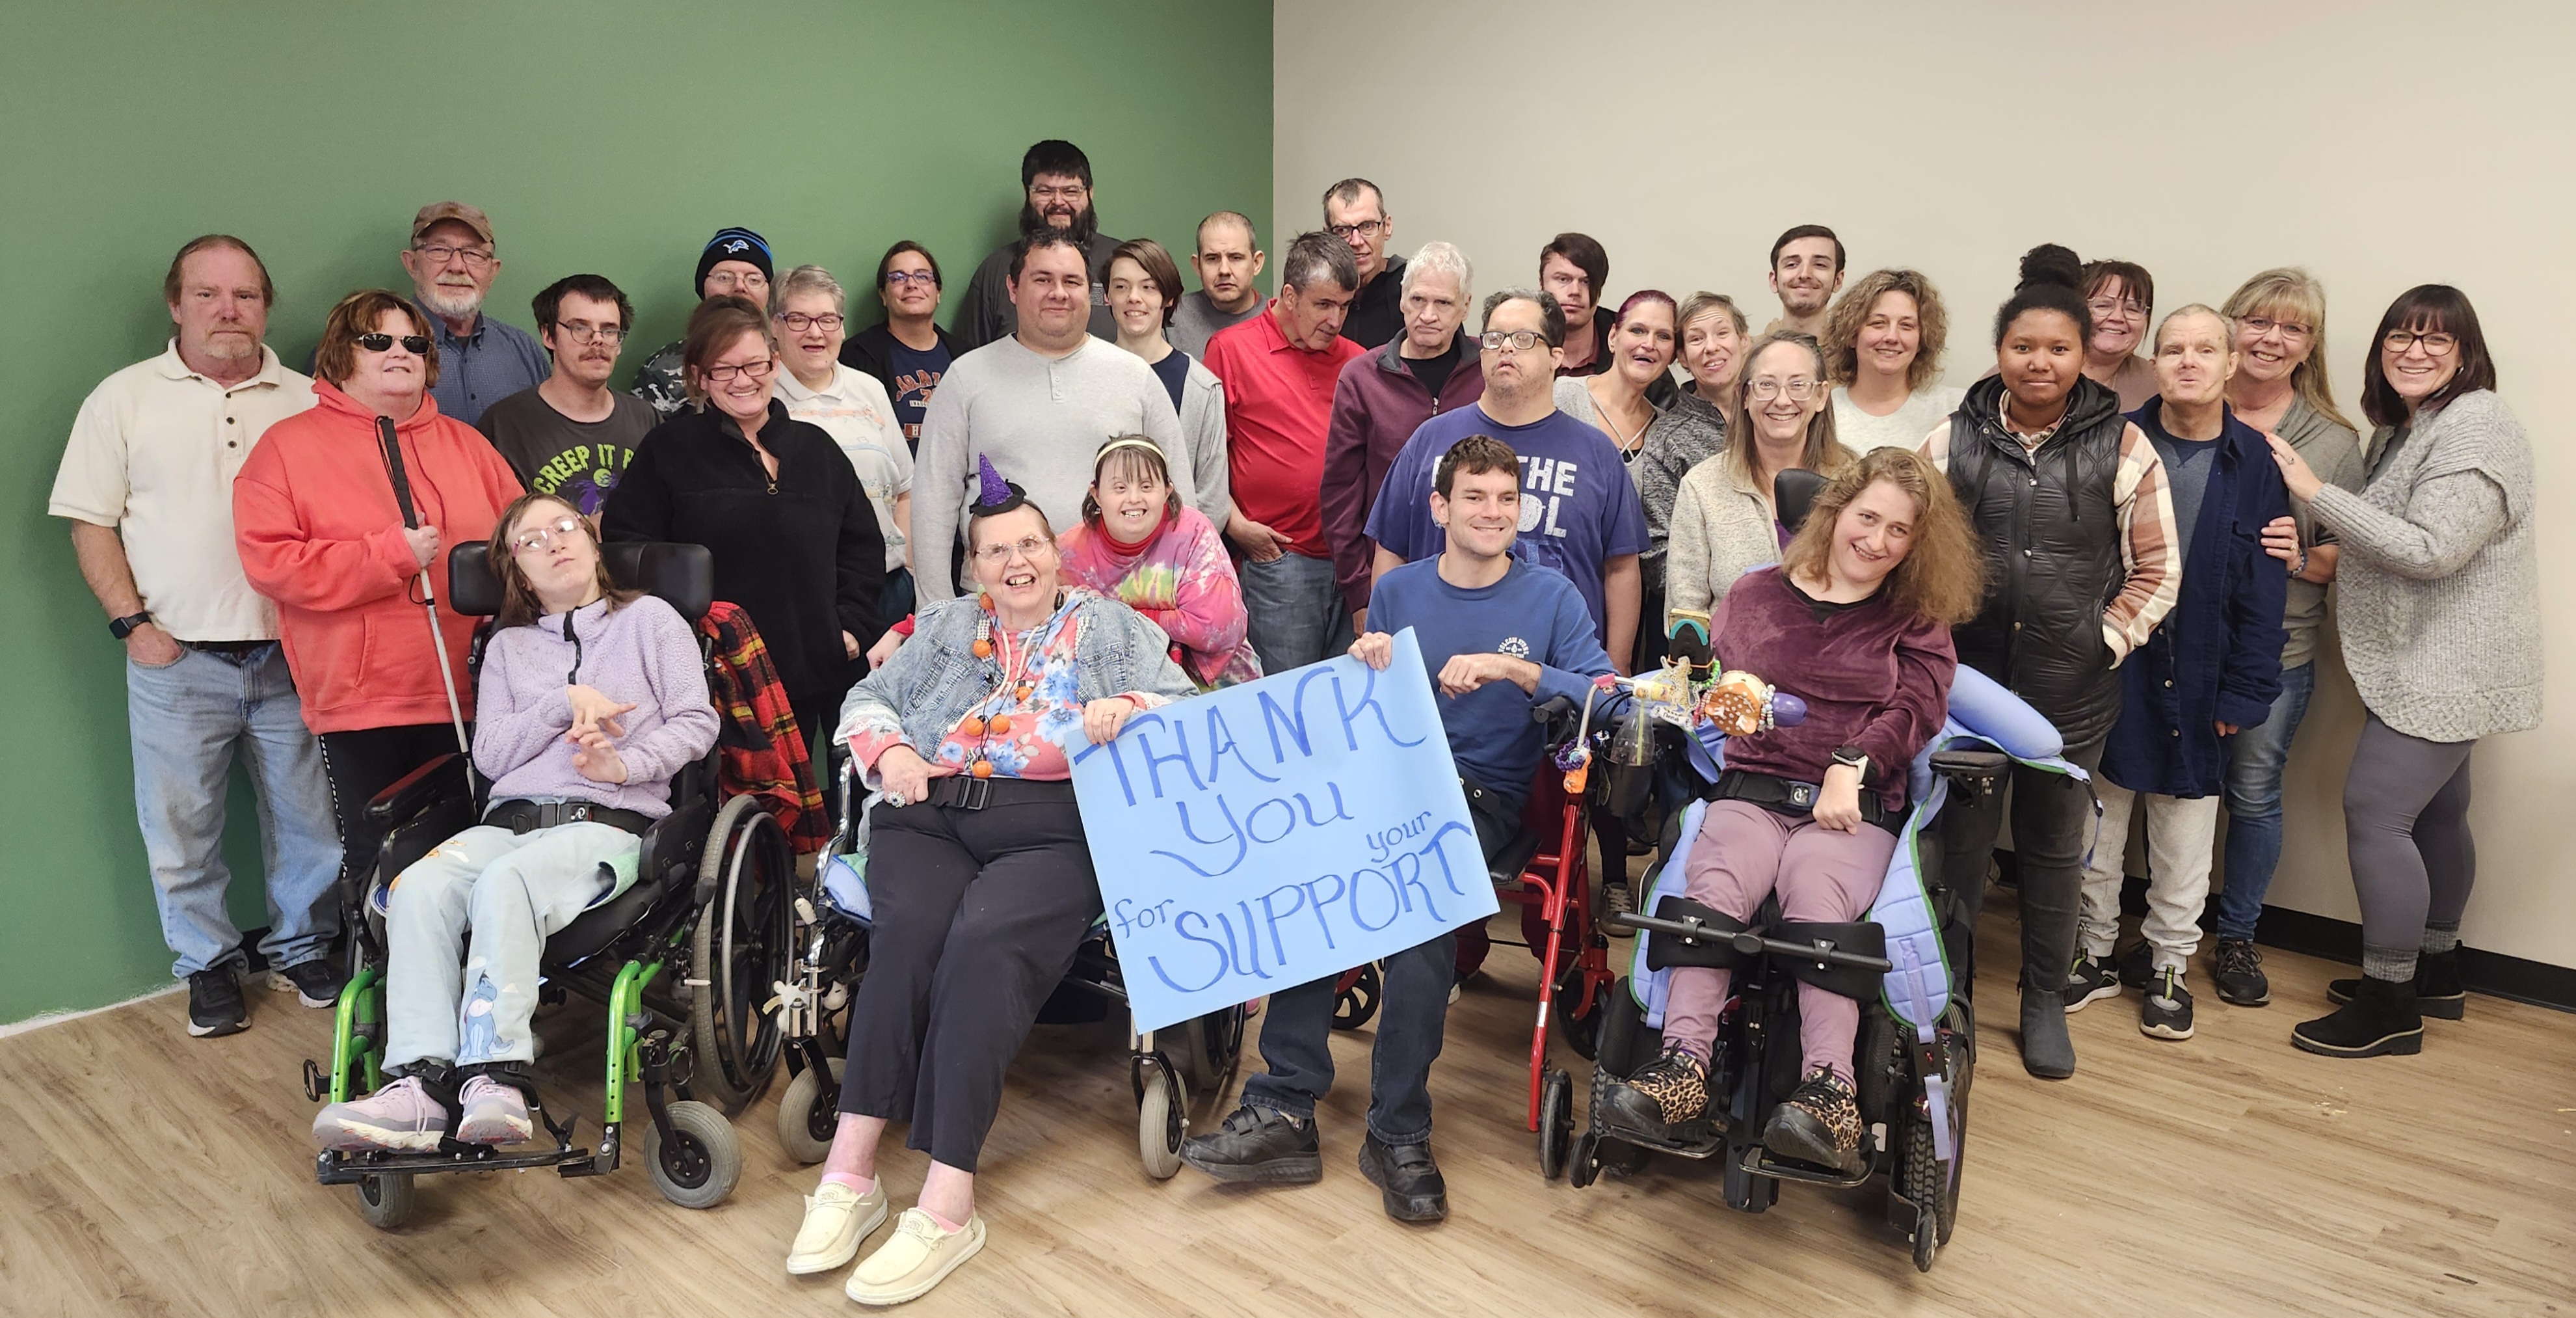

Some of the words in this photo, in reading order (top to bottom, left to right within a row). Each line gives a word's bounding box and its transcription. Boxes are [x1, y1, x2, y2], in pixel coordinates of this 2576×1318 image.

[533, 445, 590, 495] CREEP
[597, 443, 616, 469] IT
[320, 734, 331, 770] RMOUR
[1073, 666, 1427, 807] THANK
[1115, 898, 1175, 939] for
[1366, 811, 1432, 863] your
[1148, 821, 1472, 993] SUPPORT
